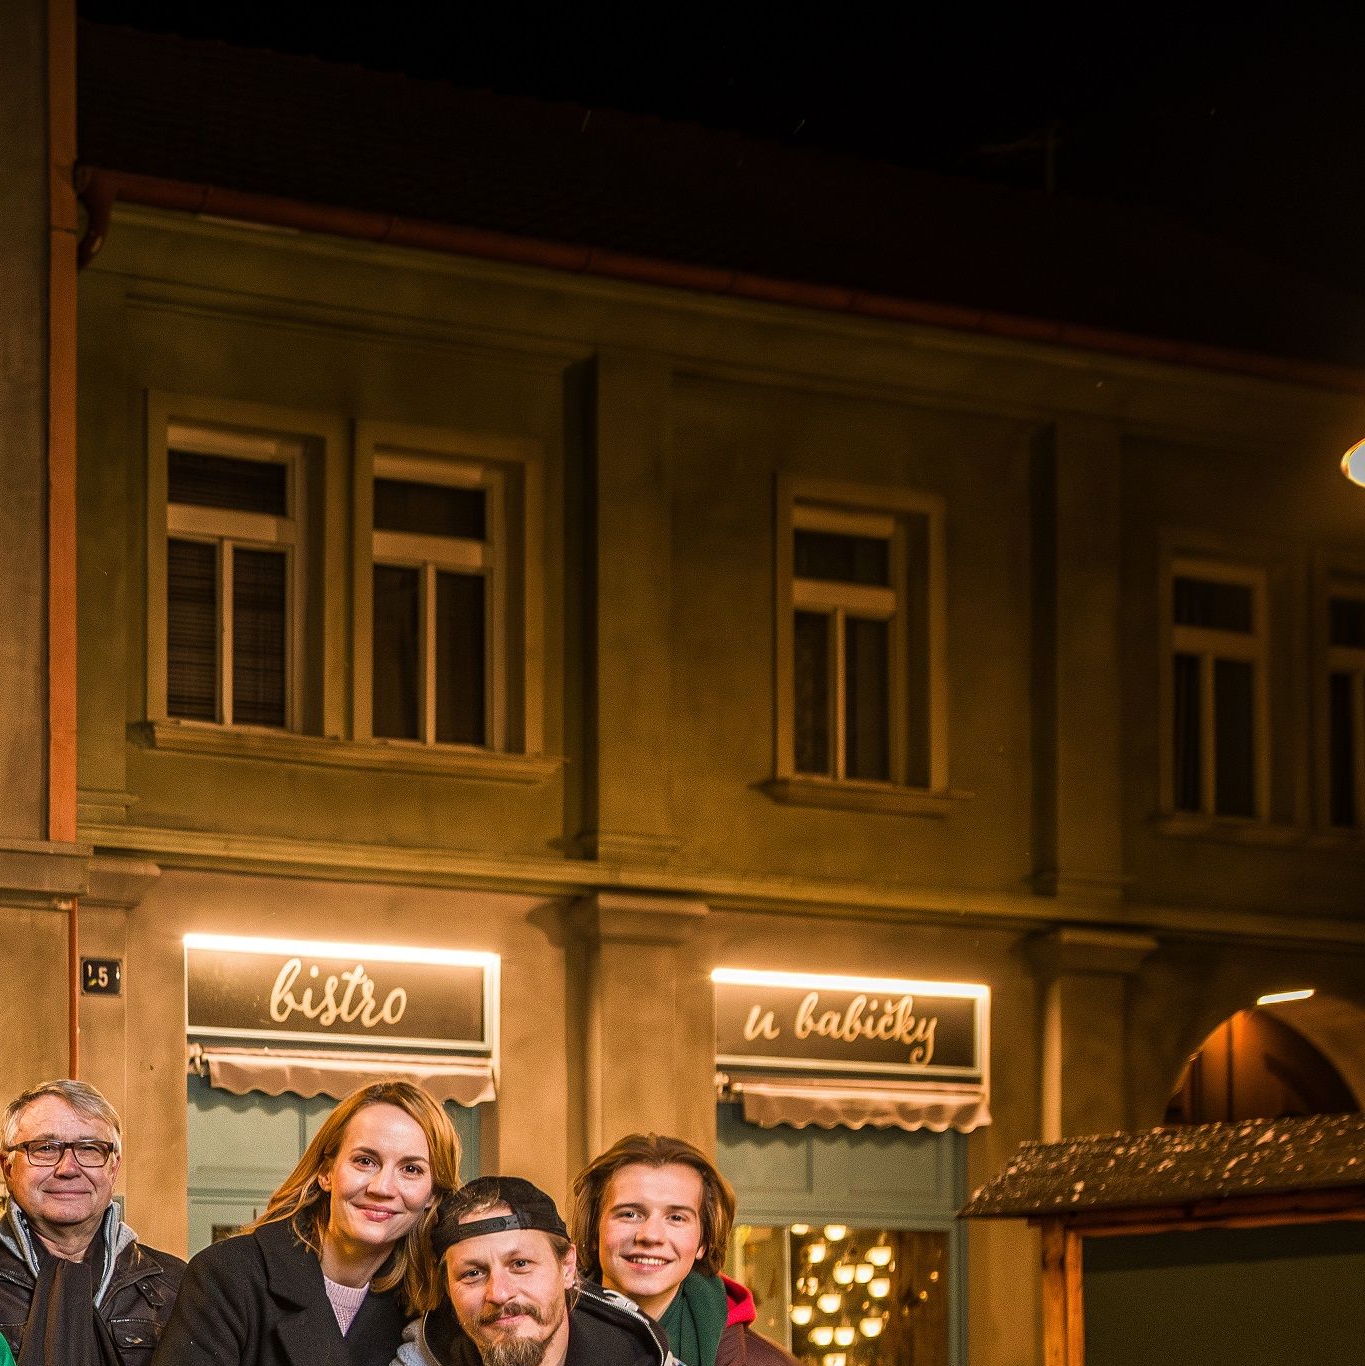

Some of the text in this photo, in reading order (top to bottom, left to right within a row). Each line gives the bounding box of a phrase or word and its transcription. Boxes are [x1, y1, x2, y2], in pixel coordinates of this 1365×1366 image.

[270, 958, 407, 1028] bistro
[744, 991, 938, 1068] u babičky
